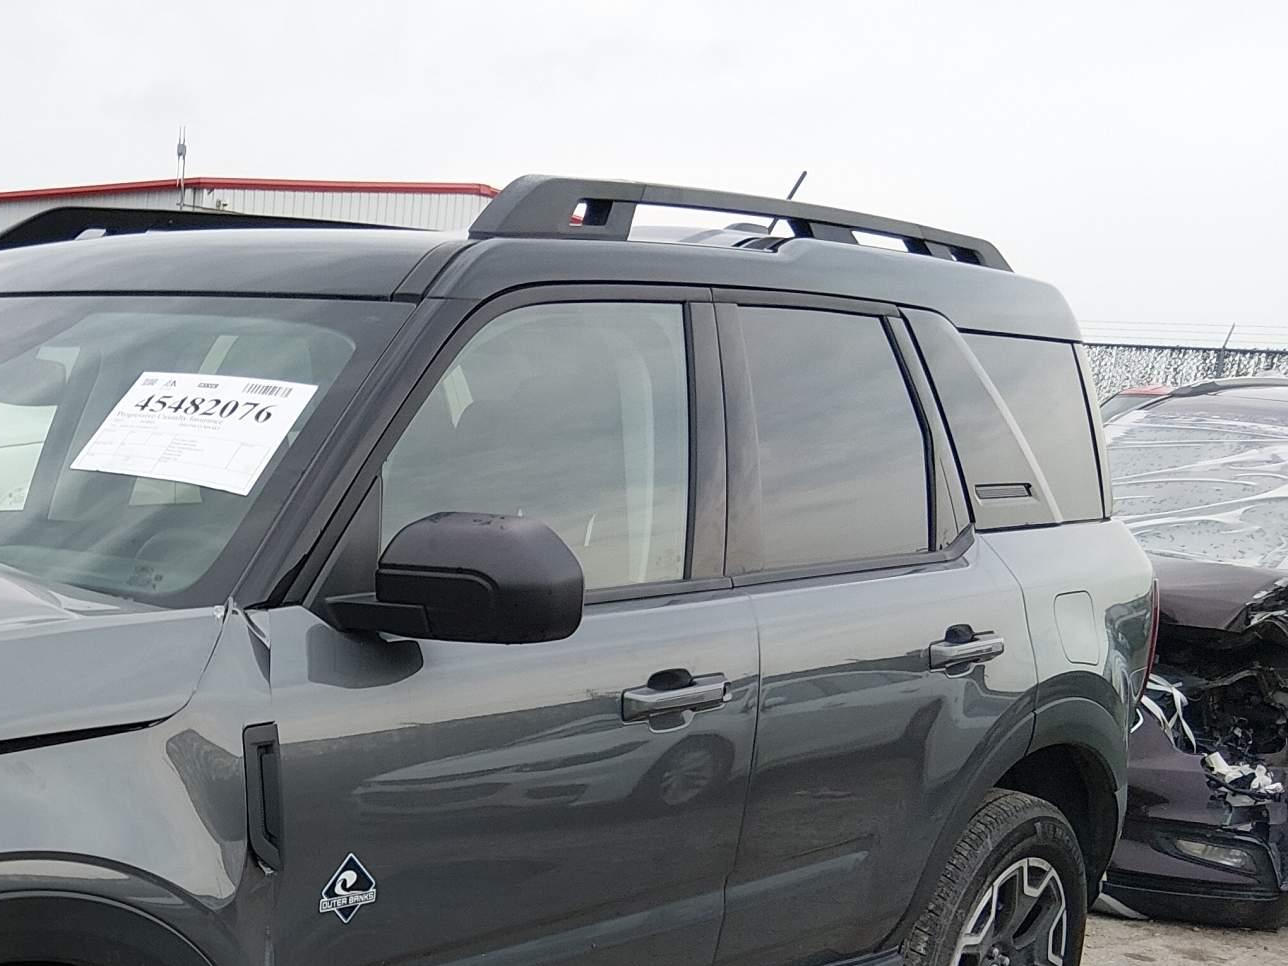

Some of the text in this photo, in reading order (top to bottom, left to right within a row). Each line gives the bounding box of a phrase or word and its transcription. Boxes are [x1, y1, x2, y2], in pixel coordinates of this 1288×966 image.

[133, 393, 278, 424] 45482076
[322, 892, 374, 910] OUTER BANKS
